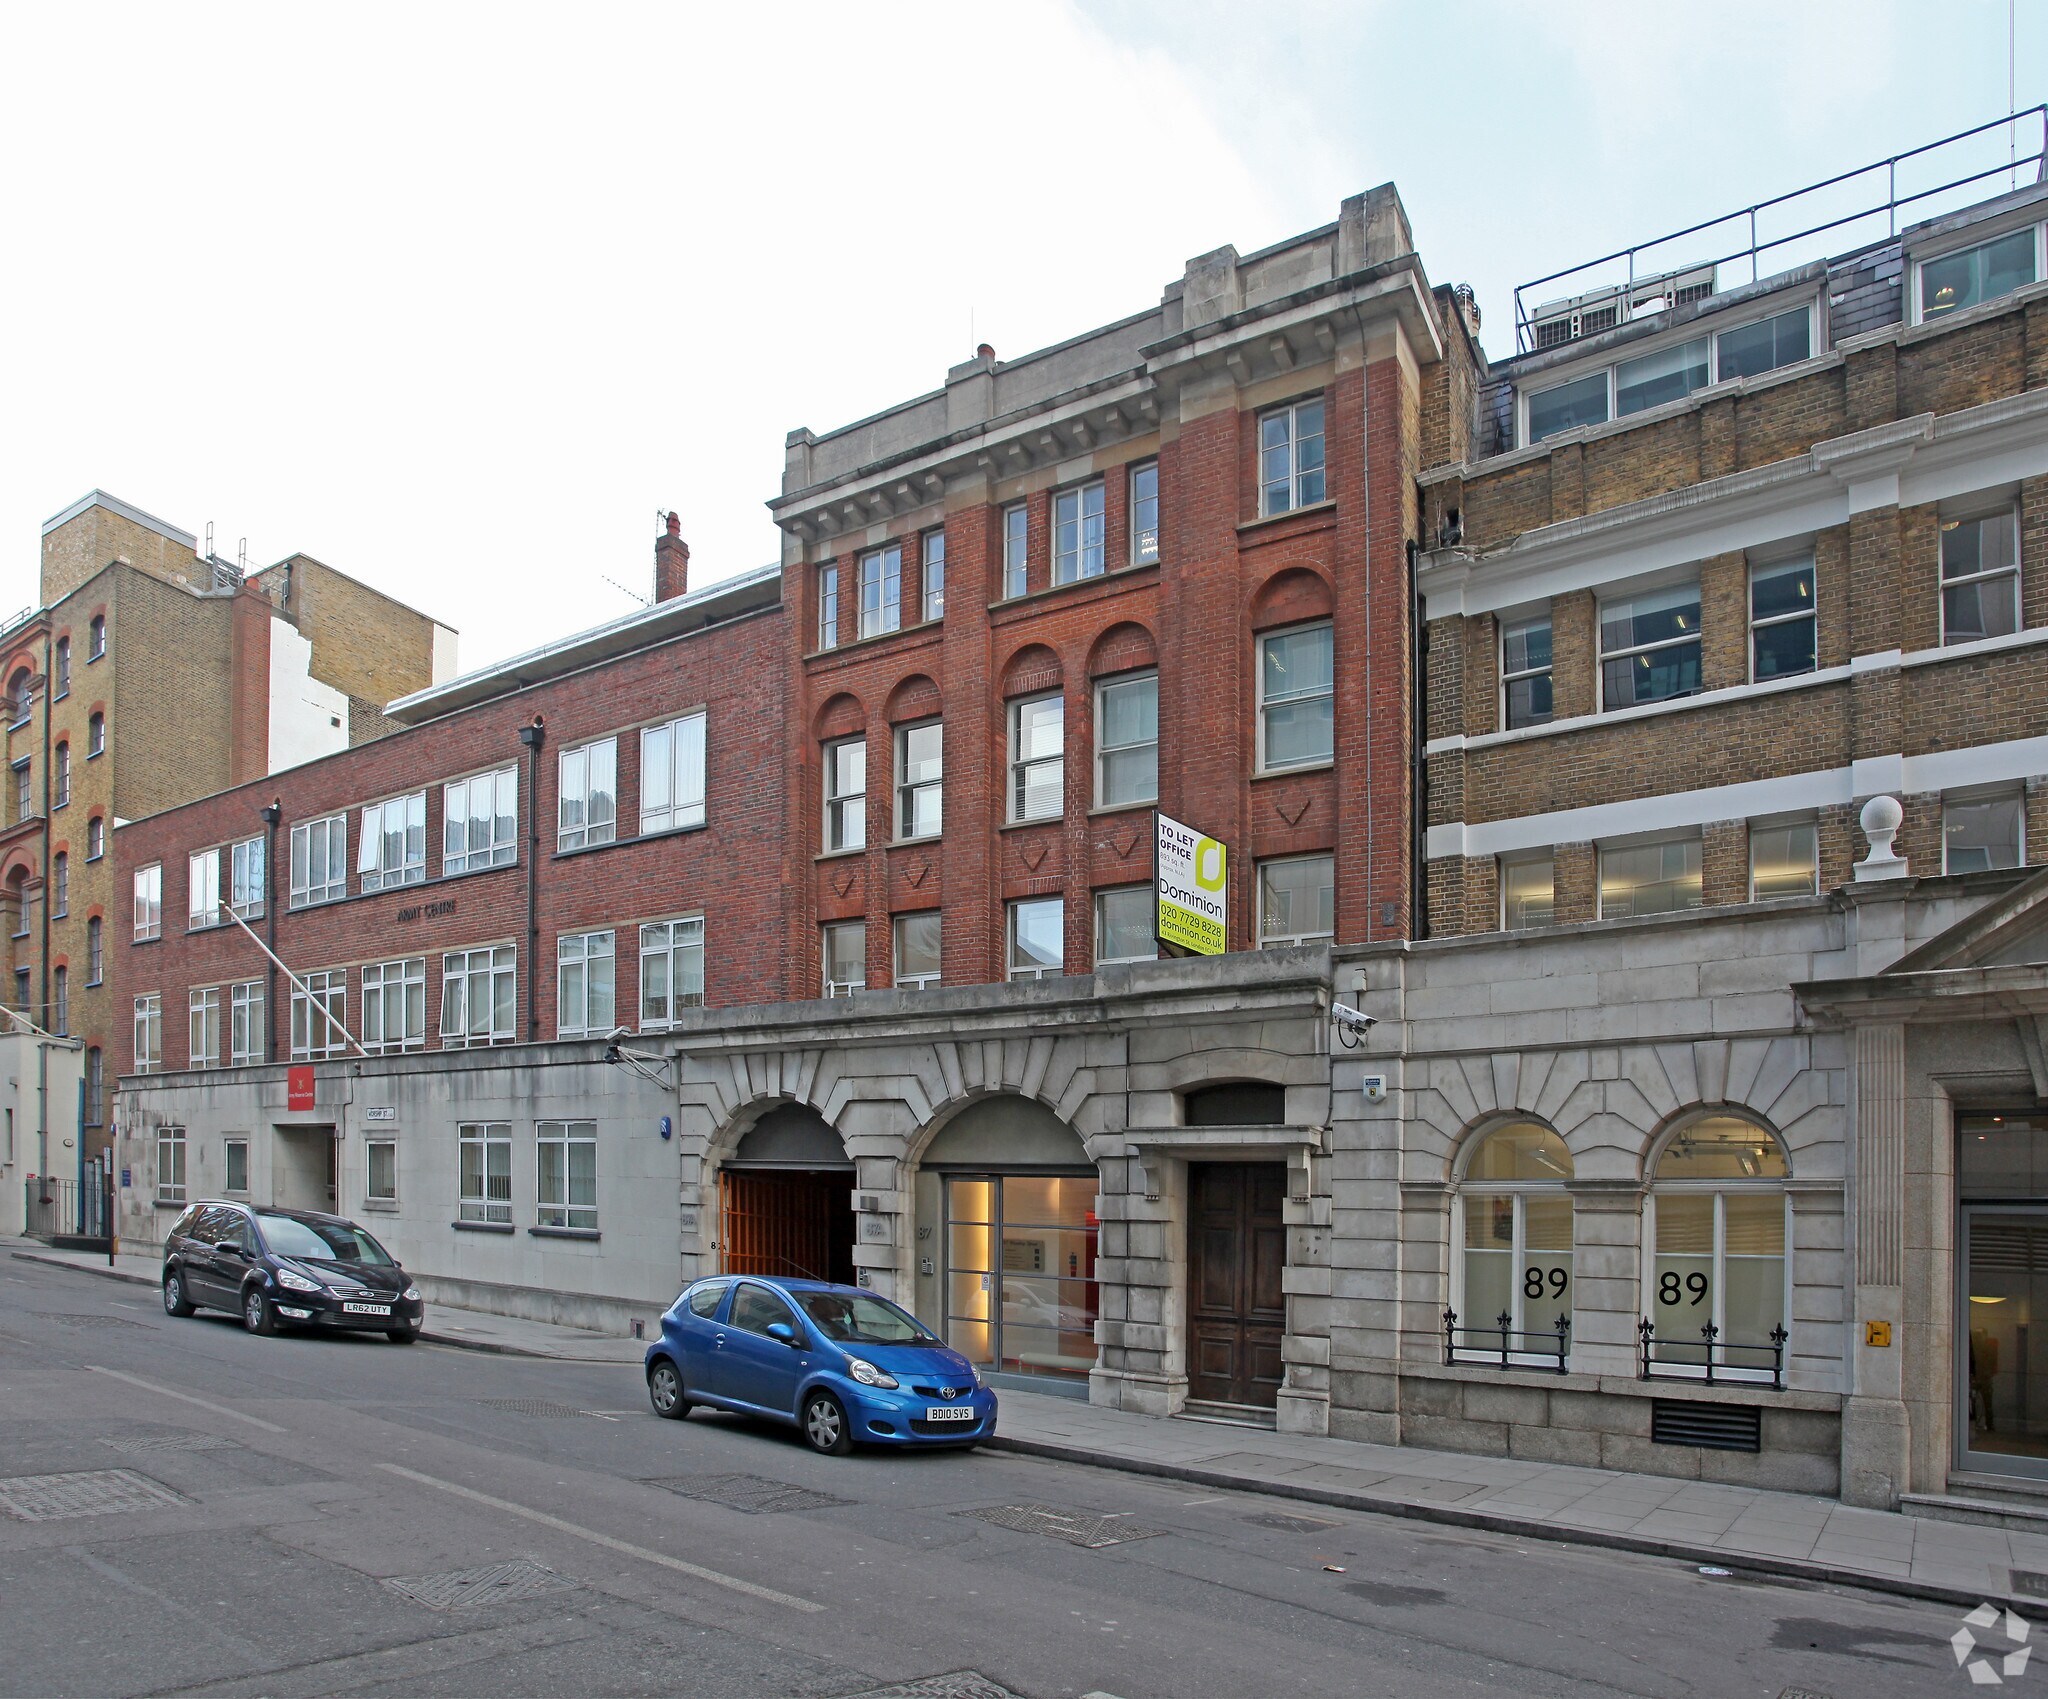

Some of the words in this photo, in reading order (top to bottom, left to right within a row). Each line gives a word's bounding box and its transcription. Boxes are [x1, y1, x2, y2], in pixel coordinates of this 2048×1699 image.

[1160, 823, 1174, 838] TO
[1176, 831, 1195, 848] LET
[1160, 838, 1192, 861] OFFICE
[397, 905, 420, 921] ARMY
[424, 899, 455, 917] CENTRE
[1160, 877, 1223, 919] Dominion
[1160, 904, 1177, 919] 020
[1180, 911, 1200, 928] 7729
[1201, 921, 1222, 938] 8228
[1160, 917, 1223, 950] dominion.co.uk
[919, 1226, 932, 1239] 87
[1523, 1266, 1568, 1300] 89
[1658, 1271, 1708, 1307] 89
[347, 1303, 370, 1312] LR62
[371, 1306, 388, 1314] UTY
[932, 1409, 952, 1419] BD10
[953, 1408, 969, 1419] SVS
